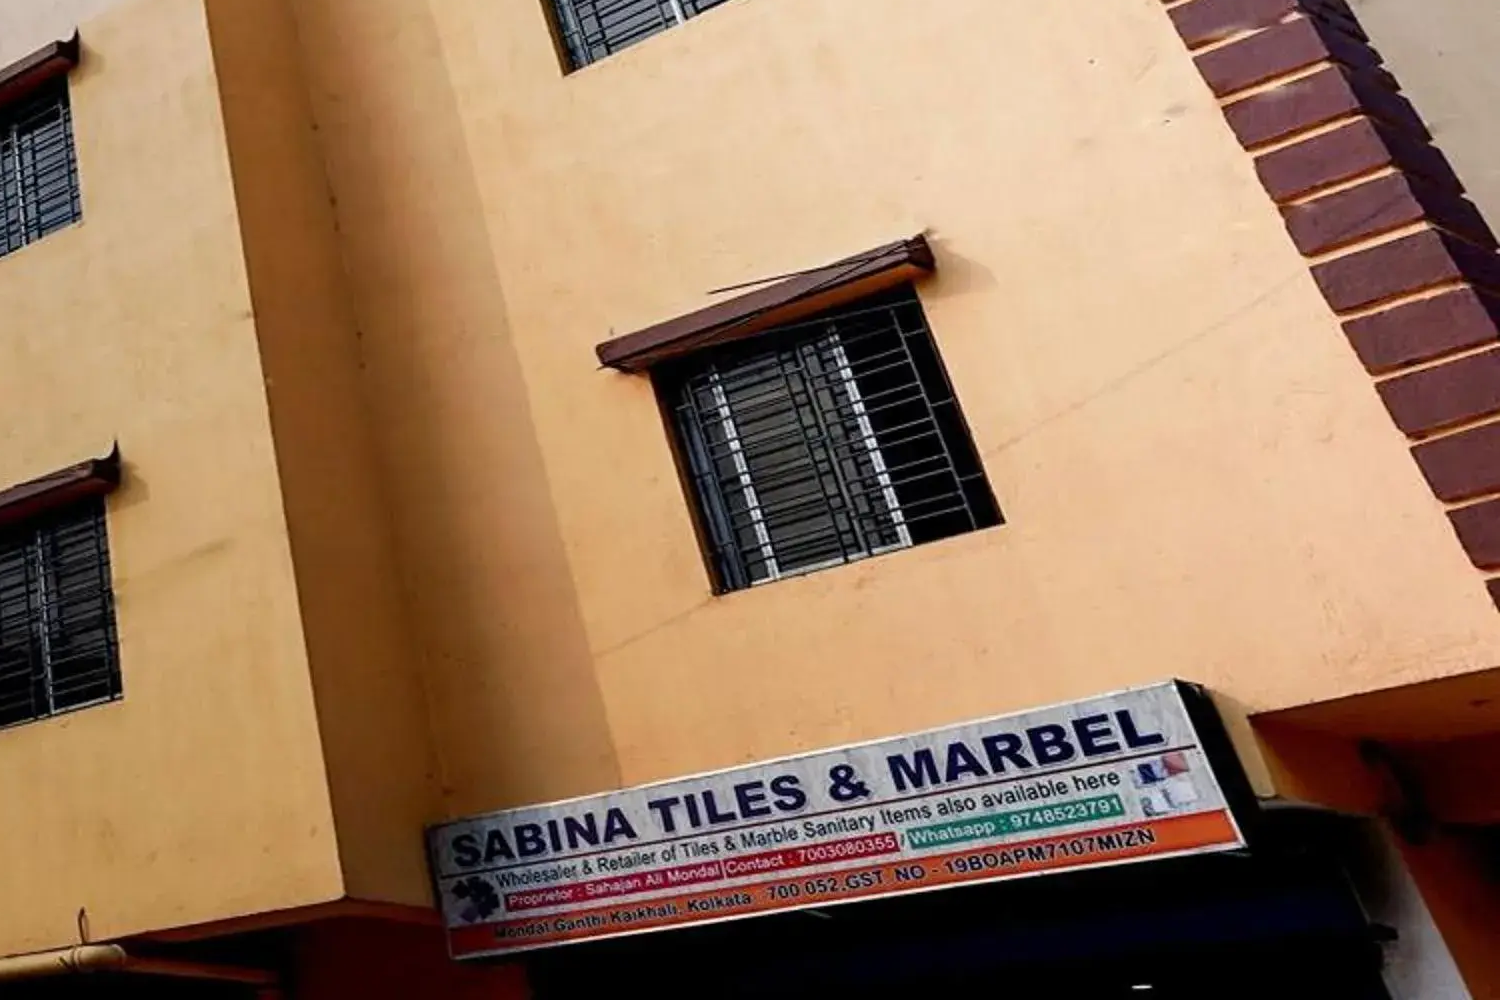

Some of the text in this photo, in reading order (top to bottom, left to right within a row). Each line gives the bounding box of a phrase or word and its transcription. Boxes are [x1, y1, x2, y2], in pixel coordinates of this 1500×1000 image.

[452, 710, 1164, 866] SABINA TILES & MARBEL
[495, 771, 1121, 888] Wholesaler & Retailer of Tiles & Marble Sanitary Items also available here
[508, 887, 574, 906] Proprietor
[586, 877, 641, 896] Sahajan
[645, 873, 663, 886] Ali
[667, 865, 719, 882] Mondal
[726, 855, 785, 873] Contact
[909, 820, 996, 845] Whatsapp
[1010, 798, 1122, 827] 9748523791
[687, 892, 751, 912] Kolkata
[767, 883, 800, 900] 700
[894, 865, 926, 882] NO
